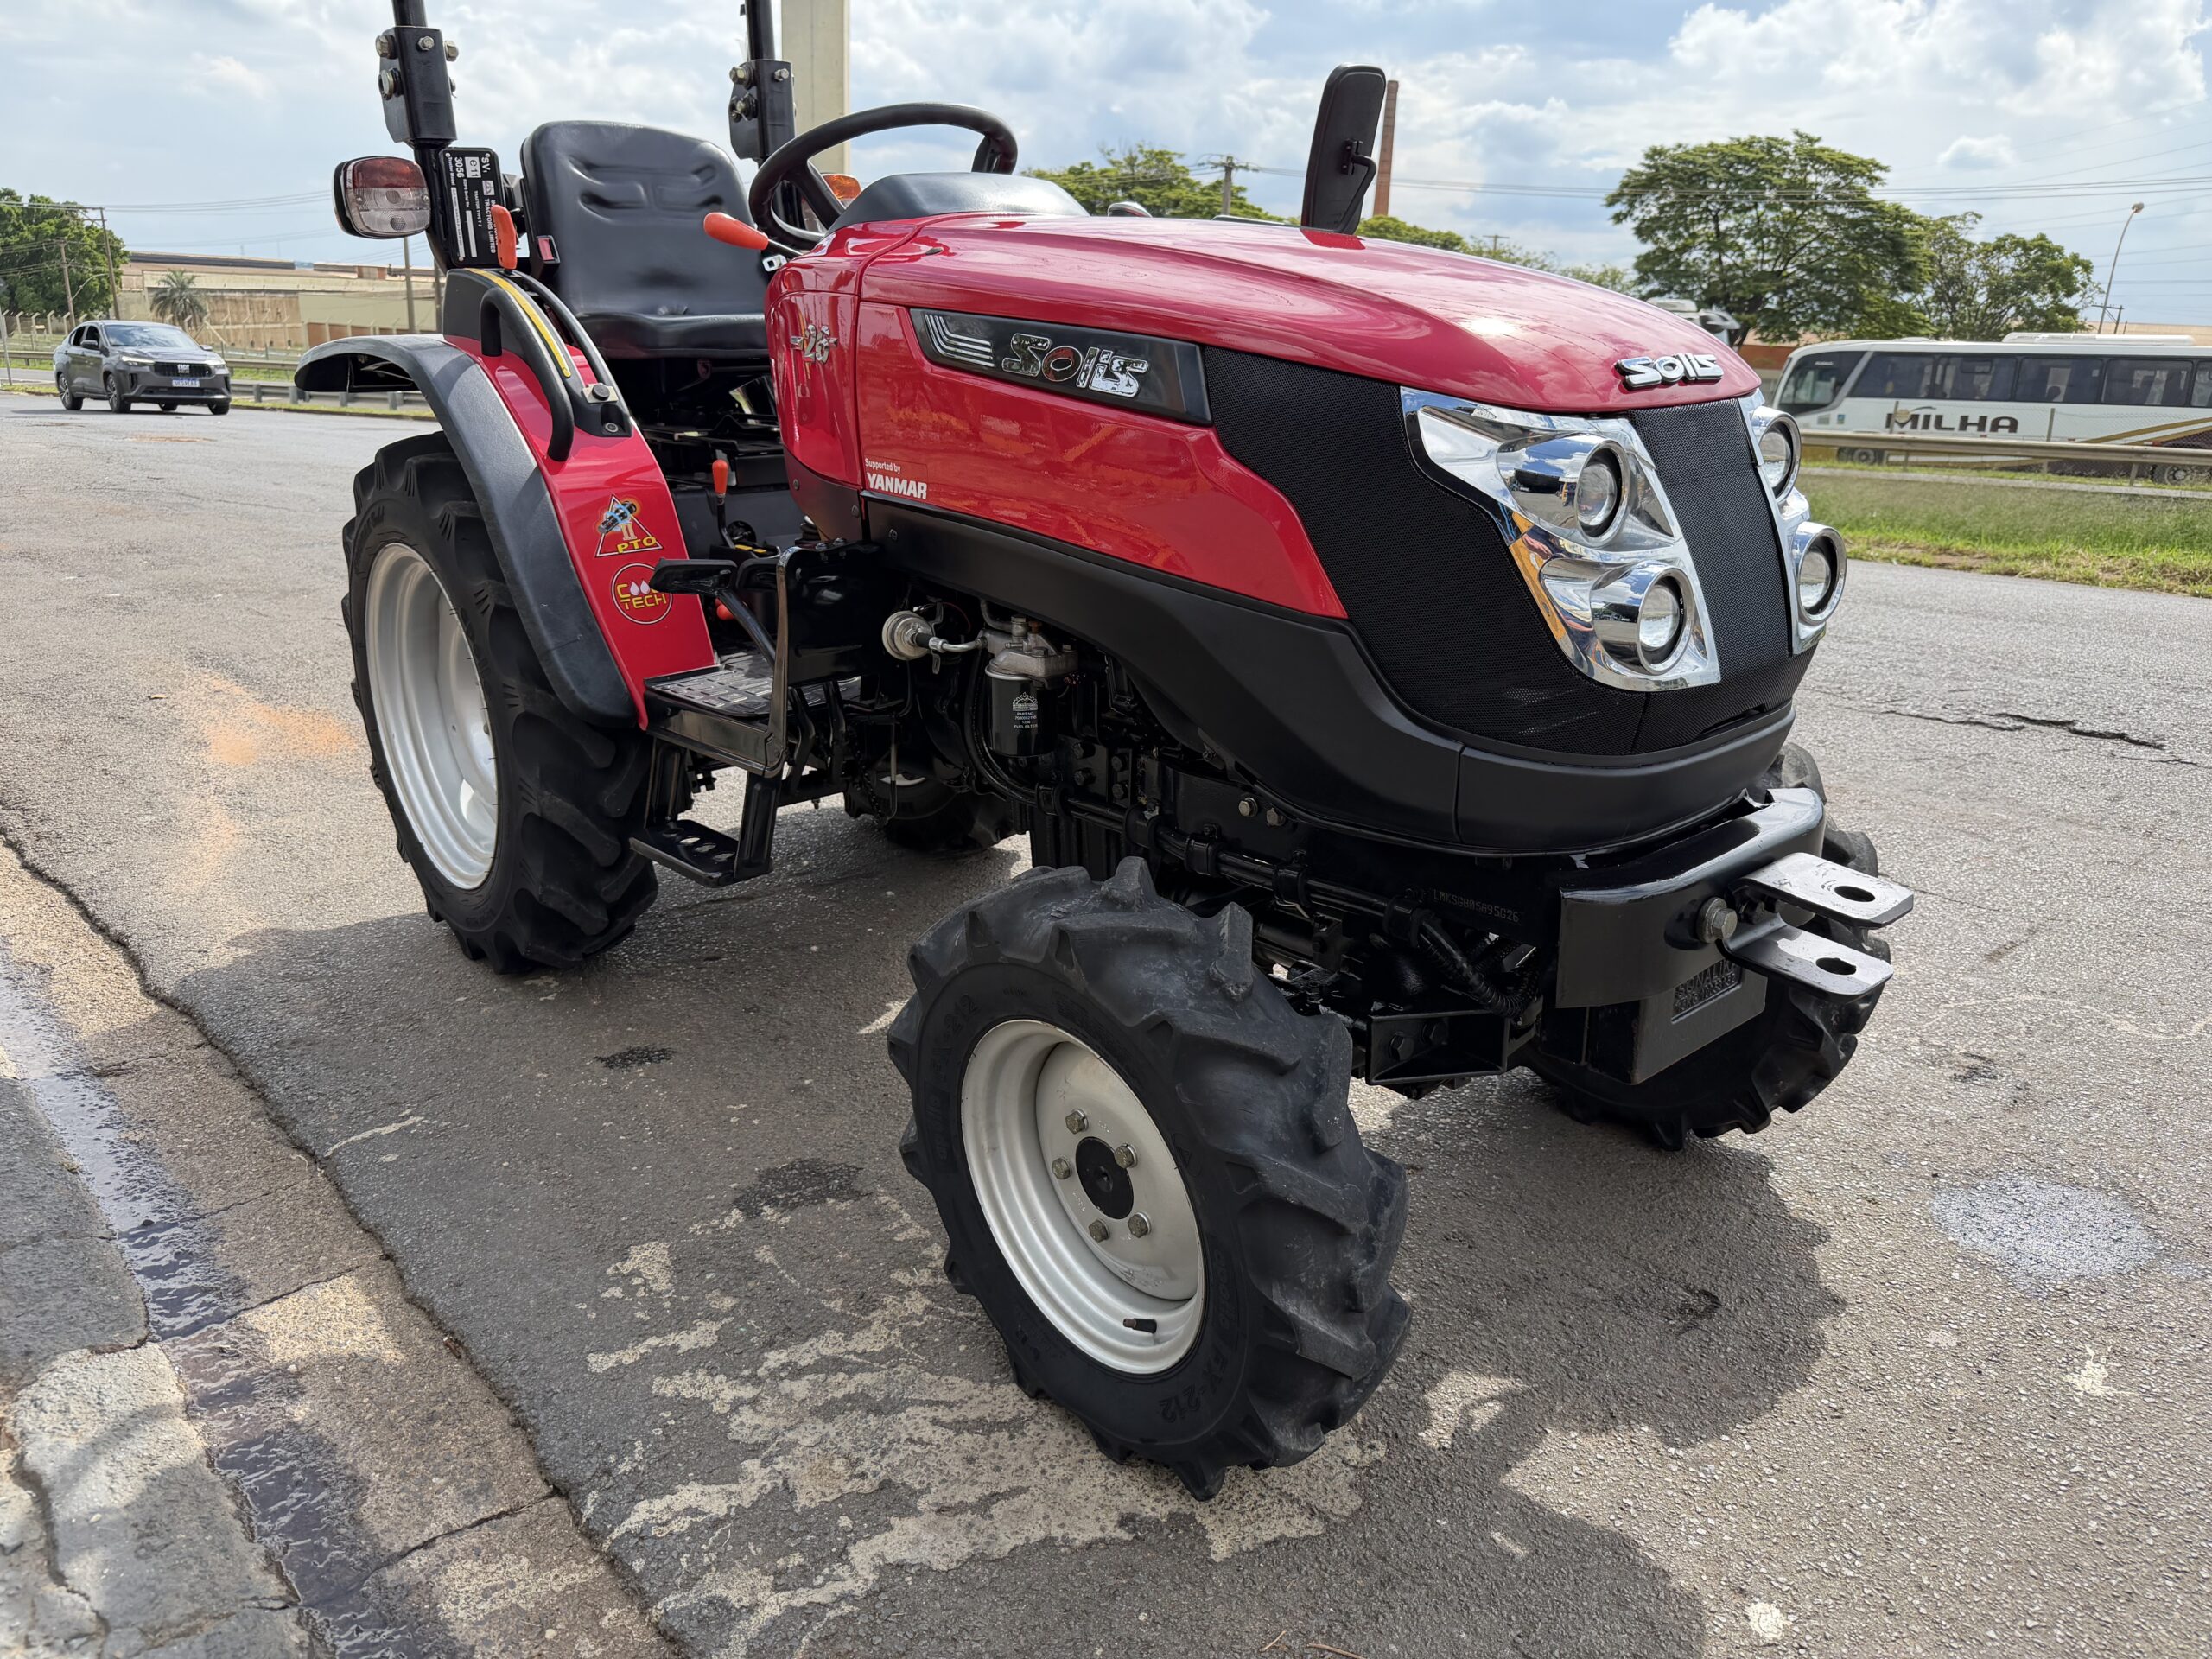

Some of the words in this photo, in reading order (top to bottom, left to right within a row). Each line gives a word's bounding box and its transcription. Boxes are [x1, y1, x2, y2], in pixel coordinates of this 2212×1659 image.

[454, 156, 465, 178] 3056
[488, 231, 497, 254] LIMITED
[804, 324, 830, 365] 26
[1885, 413, 2019, 434] MILHA
[865, 457, 893, 471] Supported
[893, 463, 901, 474] by
[867, 472, 928, 499] YANMAR
[616, 536, 657, 554] PTO
[620, 594, 667, 610] TECH
